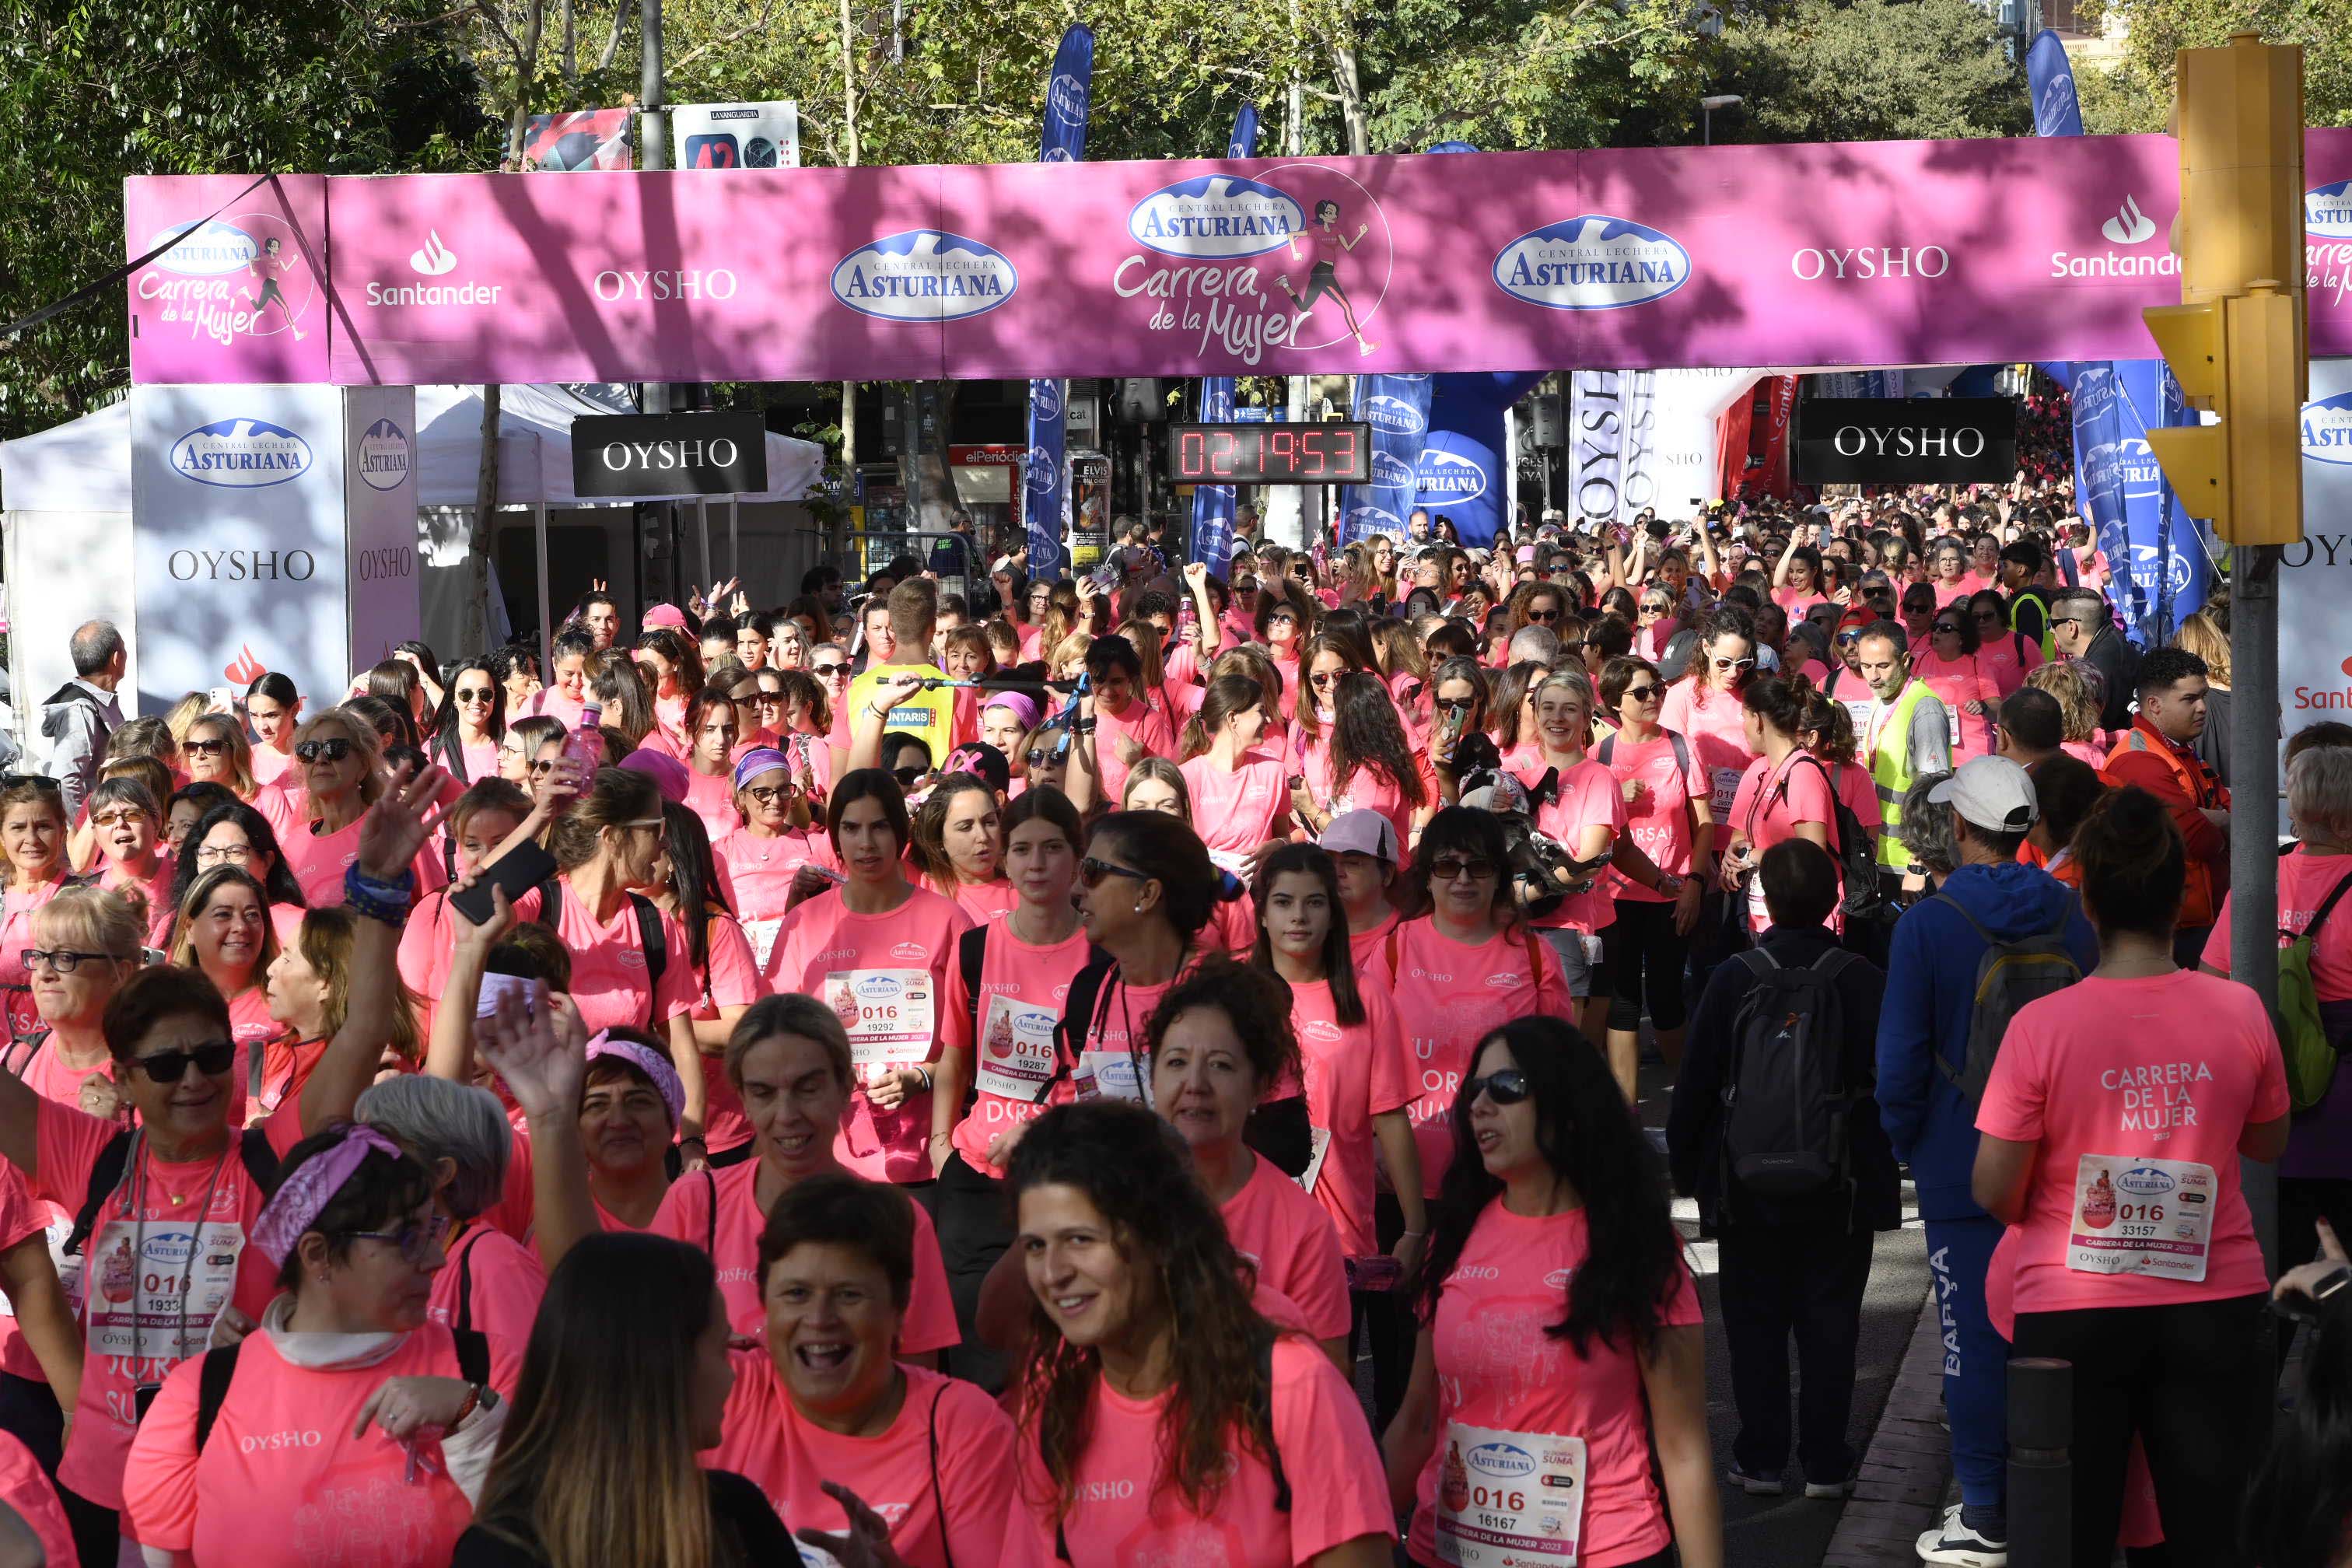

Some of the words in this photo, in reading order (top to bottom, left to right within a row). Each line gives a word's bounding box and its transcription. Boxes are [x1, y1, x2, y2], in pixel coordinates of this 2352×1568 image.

[1169, 204, 1224, 212] CENTRAL
[1230, 202, 1286, 212] LECHERA
[1142, 206, 1291, 238] ASTURIANA
[1538, 248, 1599, 258] CENTRAL
[1606, 247, 1668, 256] LECHERA
[1791, 245, 1949, 281] OYSHO
[873, 262, 932, 271] CENTRAL
[939, 261, 996, 270] LECHERA
[1113, 254, 1258, 298] Carrera
[1507, 251, 1675, 286] ASTURIANA
[138, 271, 231, 299] Carrera
[593, 268, 737, 301] OYSHO
[845, 264, 1003, 297] ASTURIANA
[366, 281, 502, 306] Santander
[161, 300, 177, 321] de
[181, 300, 194, 321] la
[191, 292, 264, 346] Mujer
[1149, 300, 1175, 330] de
[1181, 300, 1201, 330] la
[1197, 292, 1313, 366] Mujer
[1360, 403, 1418, 430] ASTURIANA
[602, 438, 738, 471] OYSHO
[1833, 425, 1986, 459] OYSHO
[181, 444, 303, 470] ASTURIANA
[362, 446, 407, 473] ASTURIANA
[1083, 465, 1108, 475] ELVIS
[359, 546, 411, 581] OYSHO
[2279, 534, 2352, 568] OY
[168, 549, 315, 581] OYSHO
[817, 948, 856, 963] OYSHO
[859, 984, 898, 994] ASTURIANA
[863, 1006, 898, 1020] 016
[867, 1023, 894, 1031] 19292
[1016, 1041, 1052, 1059] 016
[1018, 1059, 1046, 1070] 19287
[2101, 1061, 2214, 1090] CARRERA
[986, 1077, 1017, 1090] OYSHO
[2124, 1087, 2154, 1109] DE
[2163, 1084, 2192, 1106] LA
[2121, 1106, 2199, 1132] MUJER
[2121, 1177, 2171, 1189] ASTURIANA
[2119, 1204, 2165, 1220] 016
[2085, 1238, 2122, 1247] CARRERA
[2122, 1226, 2156, 1236] 33157
[2079, 1252, 2120, 1265] OYSHO
[2152, 1258, 2196, 1270] Santander
[240, 1430, 322, 1454] OYSHO
[1472, 1452, 1530, 1472] ASTURIANA
[1542, 1455, 1573, 1466] SUMA
[1473, 1486, 1524, 1511] 016
[1478, 1514, 1517, 1530] 16167
[1480, 1532, 1492, 1542] DE
[1493, 1535, 1504, 1544] LA
[1506, 1537, 1538, 1549] MUJER
[1540, 1542, 1562, 1551] 2023
